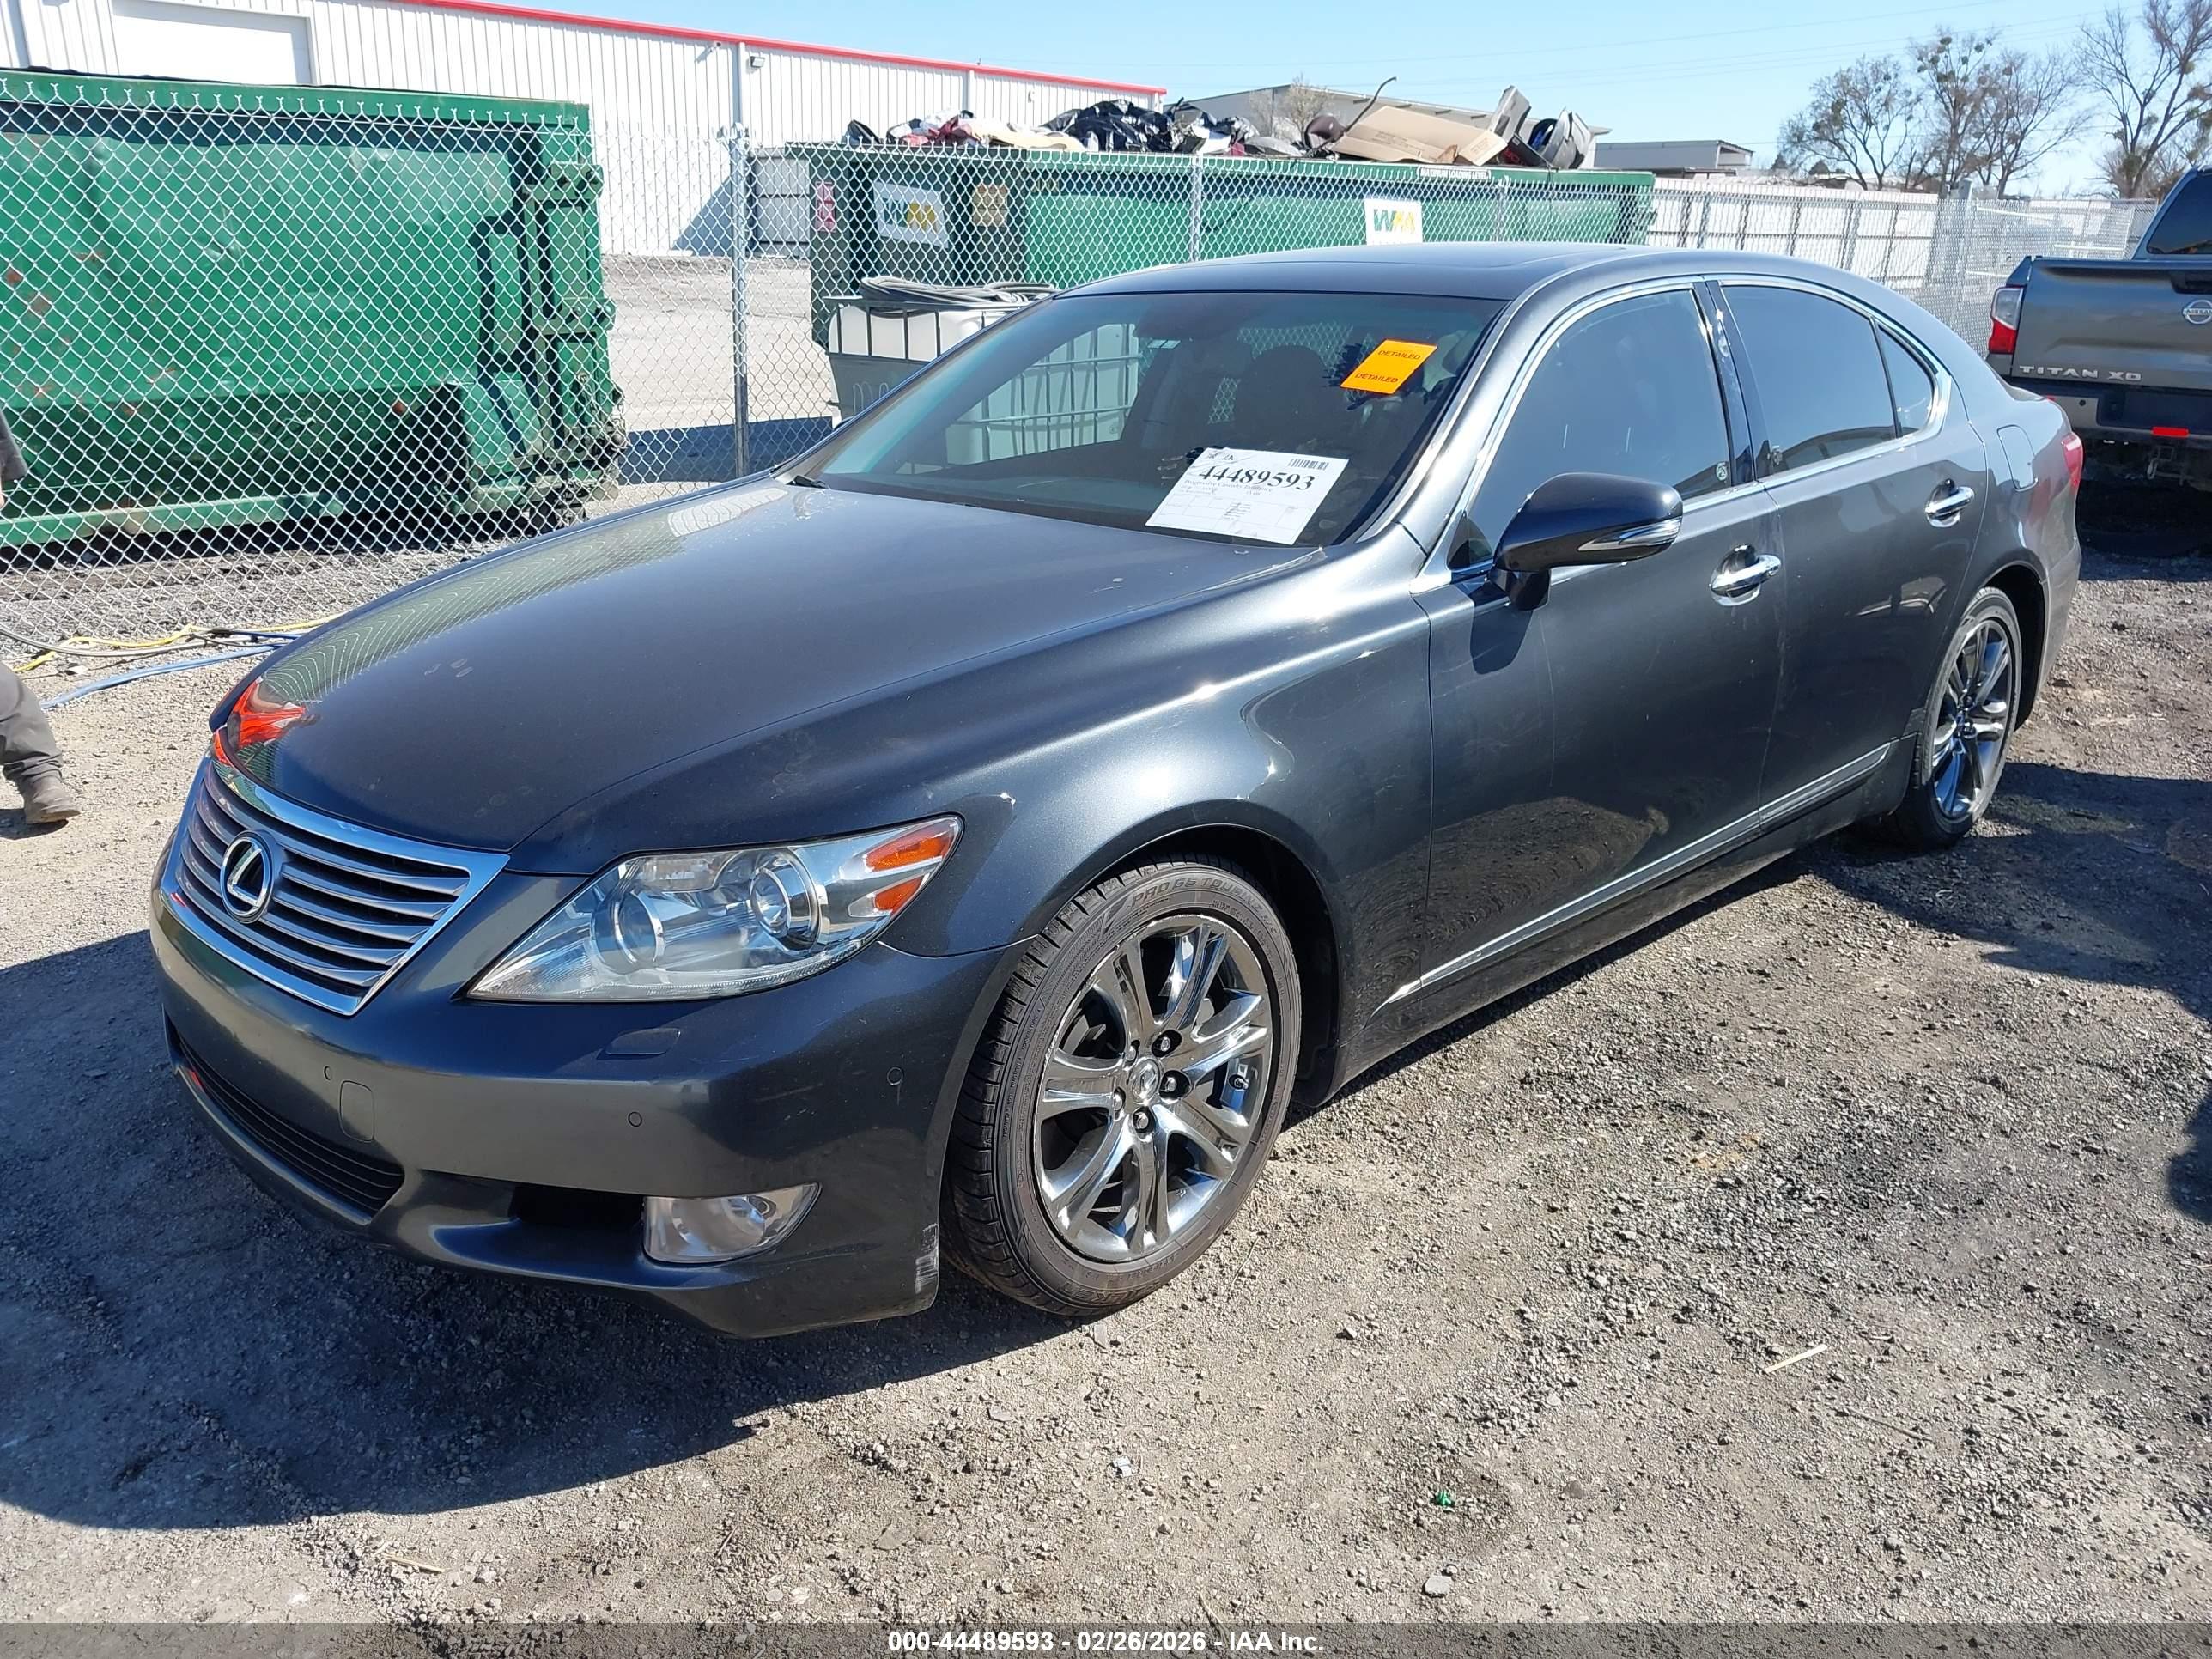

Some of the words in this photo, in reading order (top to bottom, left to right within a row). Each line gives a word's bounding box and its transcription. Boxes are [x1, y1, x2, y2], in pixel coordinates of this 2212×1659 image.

[1374, 209, 1415, 234] WM
[1377, 349, 1421, 360] DETAILED
[1354, 373, 1399, 383] DETAILED
[2019, 365, 2098, 379] TITAN
[2108, 371, 2142, 381] XD
[1199, 465, 1315, 490] 44489593
